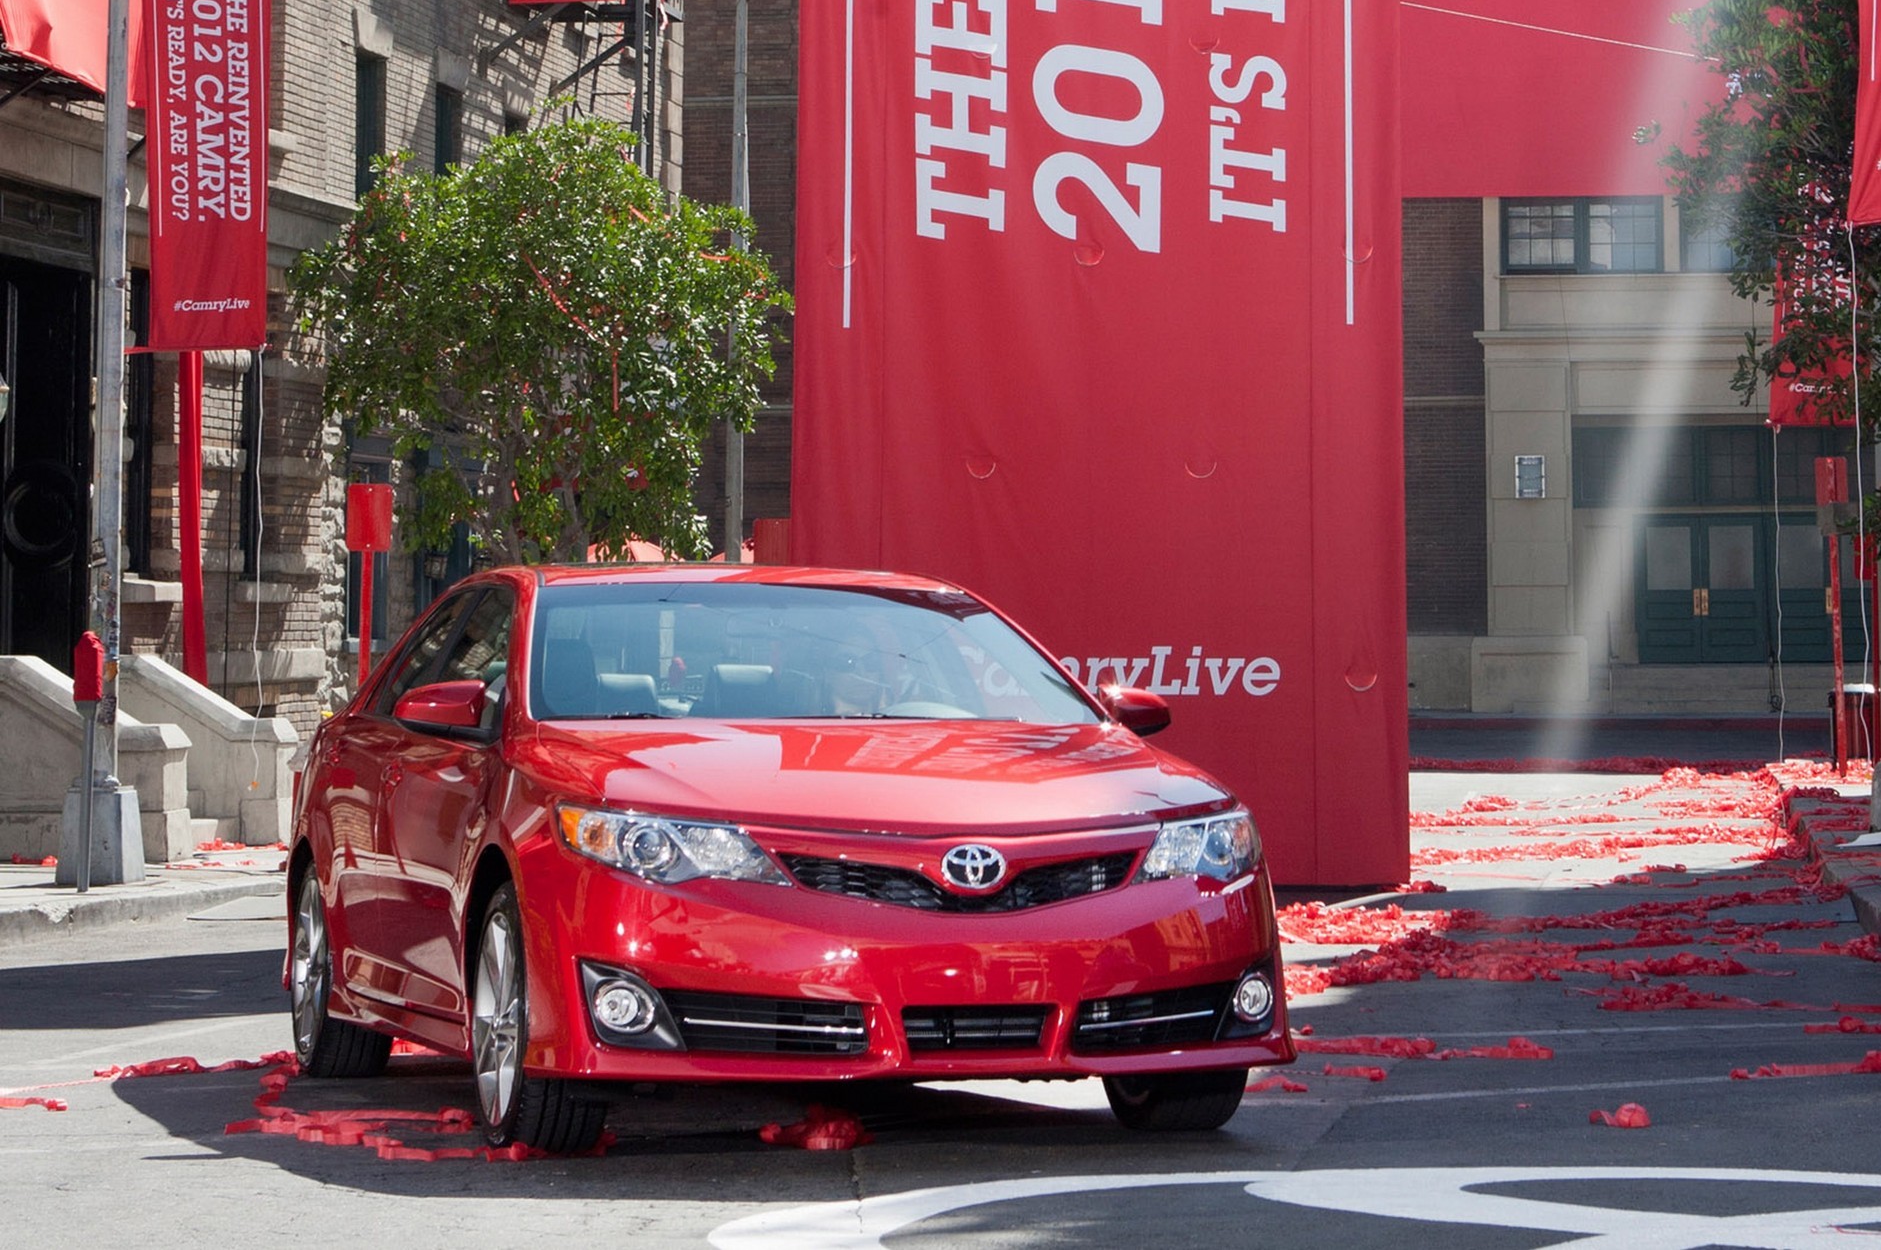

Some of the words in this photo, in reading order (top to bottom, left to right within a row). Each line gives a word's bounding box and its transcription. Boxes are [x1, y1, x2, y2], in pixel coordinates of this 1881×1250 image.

[166, 24, 187, 103] READY,
[170, 110, 188, 156] ARE
[194, 74, 226, 222] CAMRY.
[226, 39, 251, 221] REINVENTED
[1209, 53, 1287, 232] IT'S
[171, 161, 190, 221] YOU?
[174, 298, 250, 312] #CamryLive
